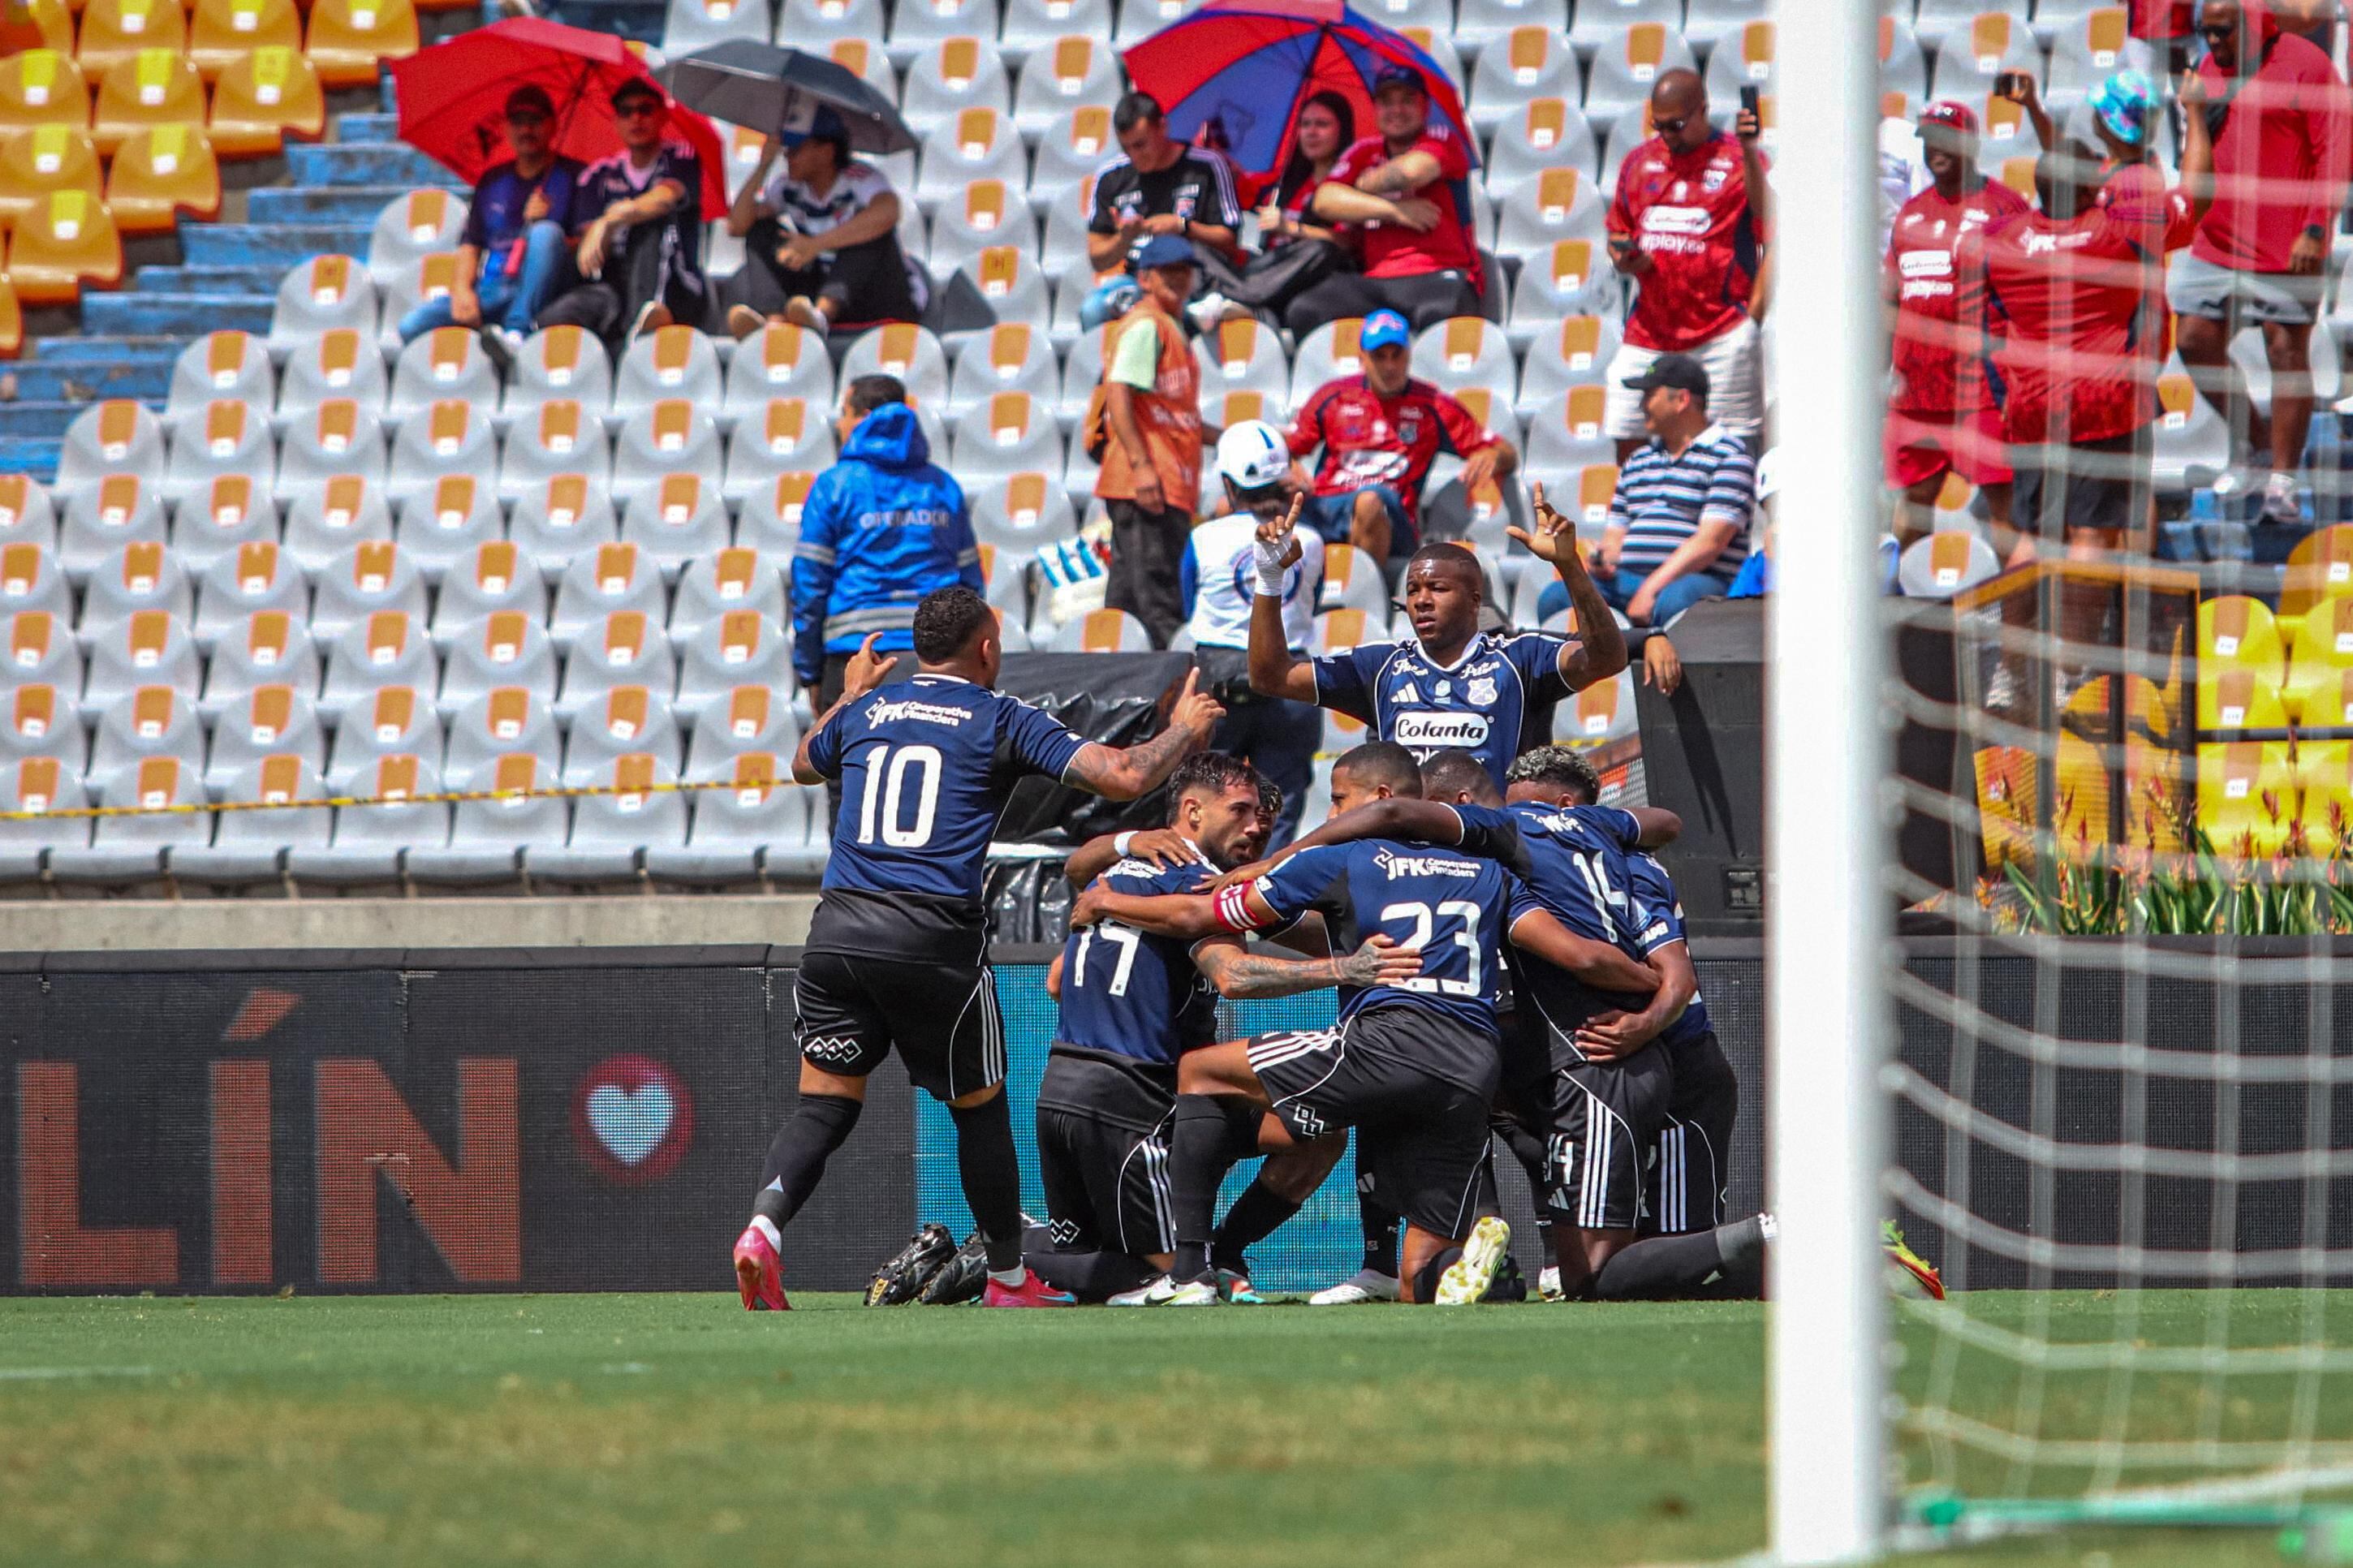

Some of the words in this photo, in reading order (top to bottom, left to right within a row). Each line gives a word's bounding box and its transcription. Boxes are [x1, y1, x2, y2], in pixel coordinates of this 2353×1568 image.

[868, 701, 910, 730] JFK
[1397, 718, 1485, 739] Colanta
[857, 744, 942, 848] 10
[1387, 857, 1430, 881] JFK
[1073, 917, 1144, 997] 17
[1381, 900, 1481, 997] 23
[18, 988, 521, 1286] LÍN
